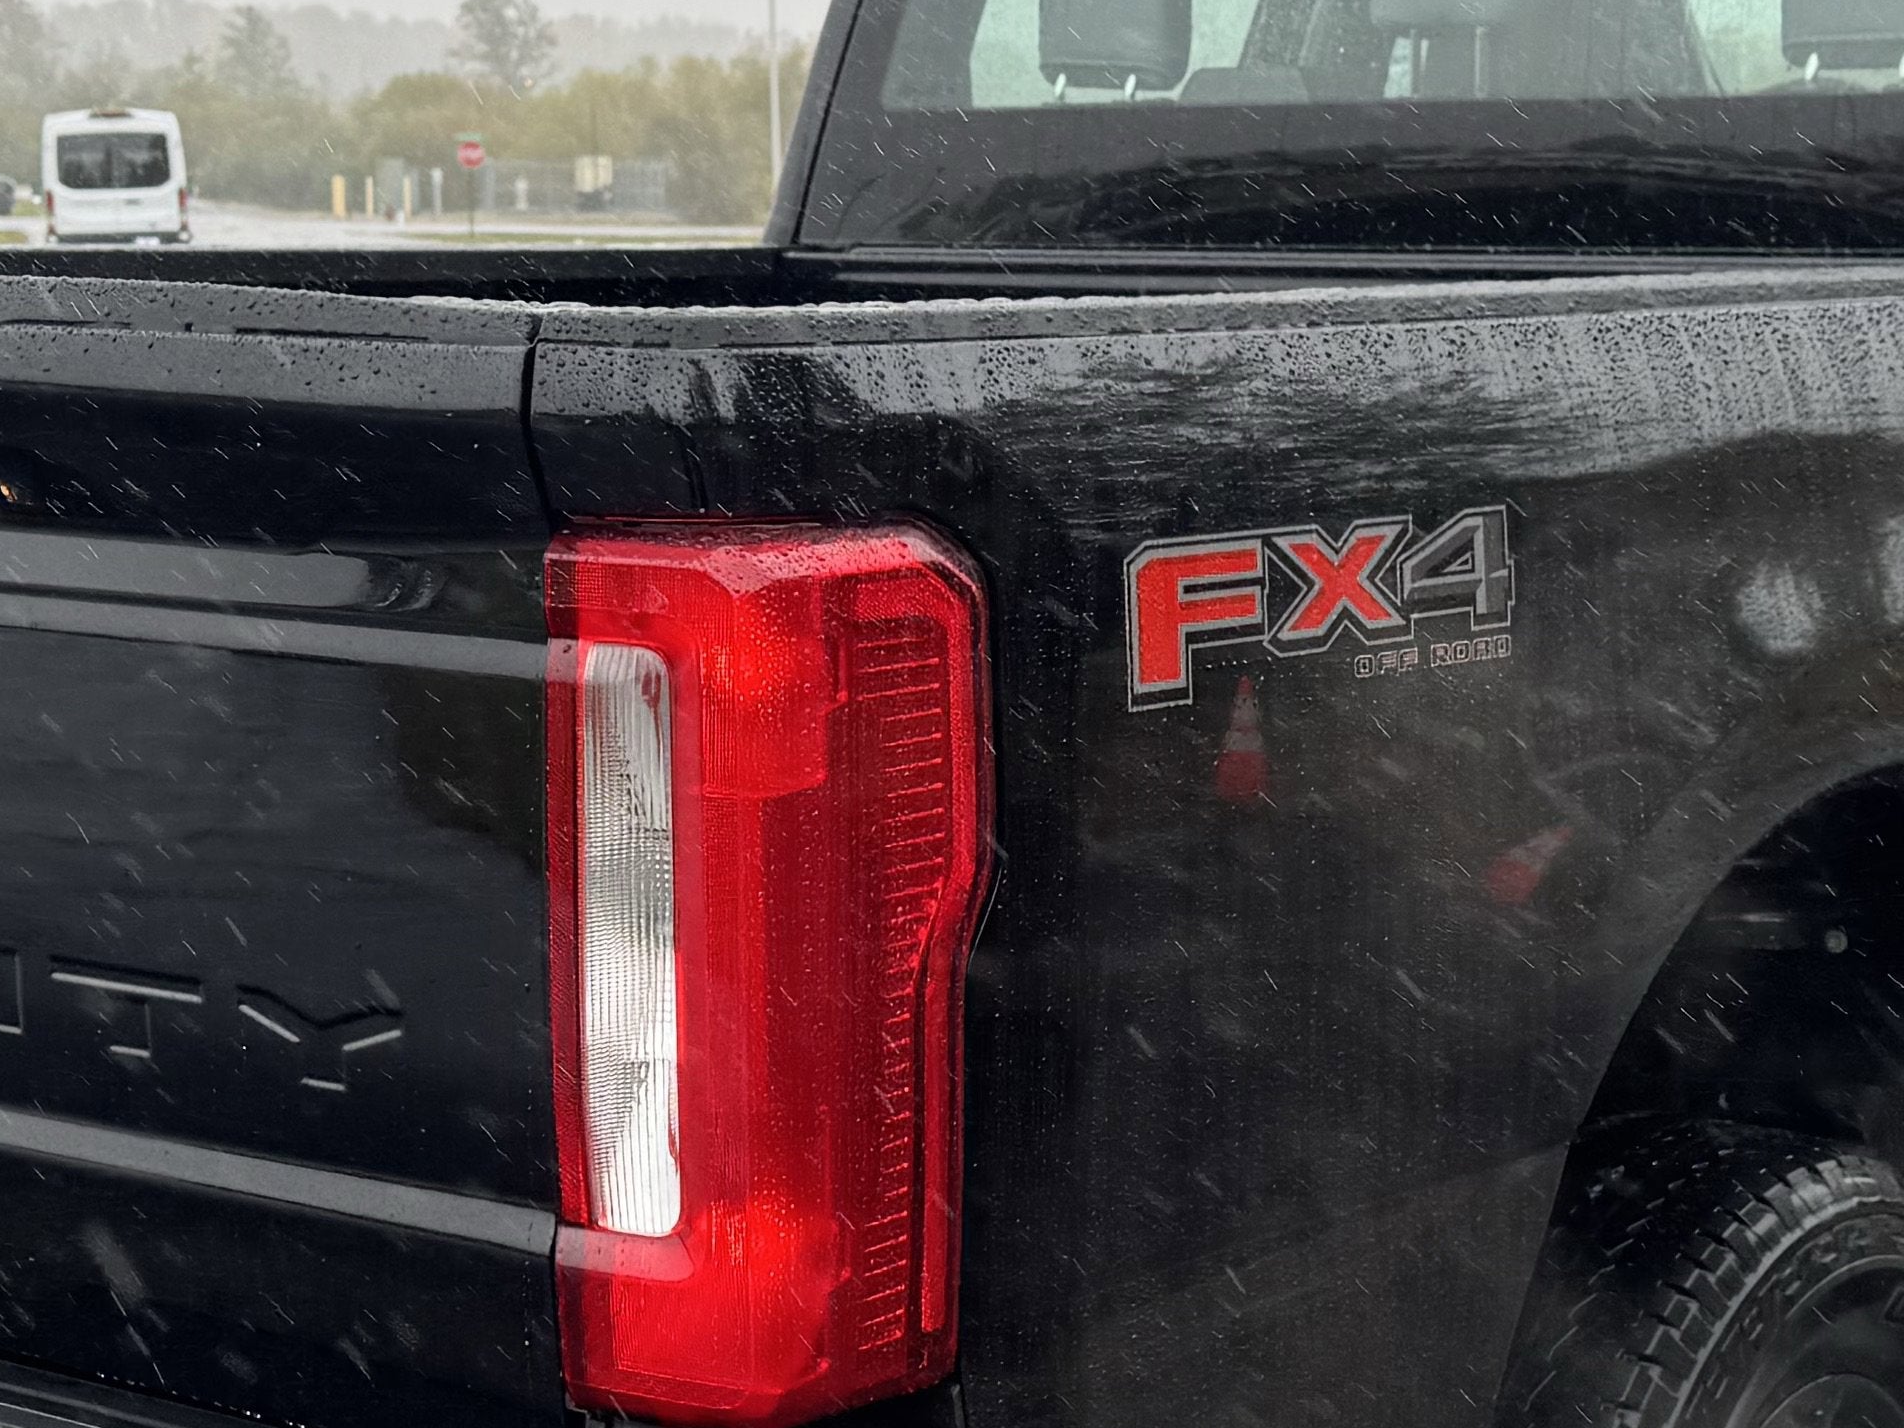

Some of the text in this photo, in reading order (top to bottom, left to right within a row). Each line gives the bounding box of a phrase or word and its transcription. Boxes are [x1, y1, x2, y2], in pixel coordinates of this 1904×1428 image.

[1124, 504, 1516, 712] FX4
[1354, 634, 1511, 678] OFF ROAD
